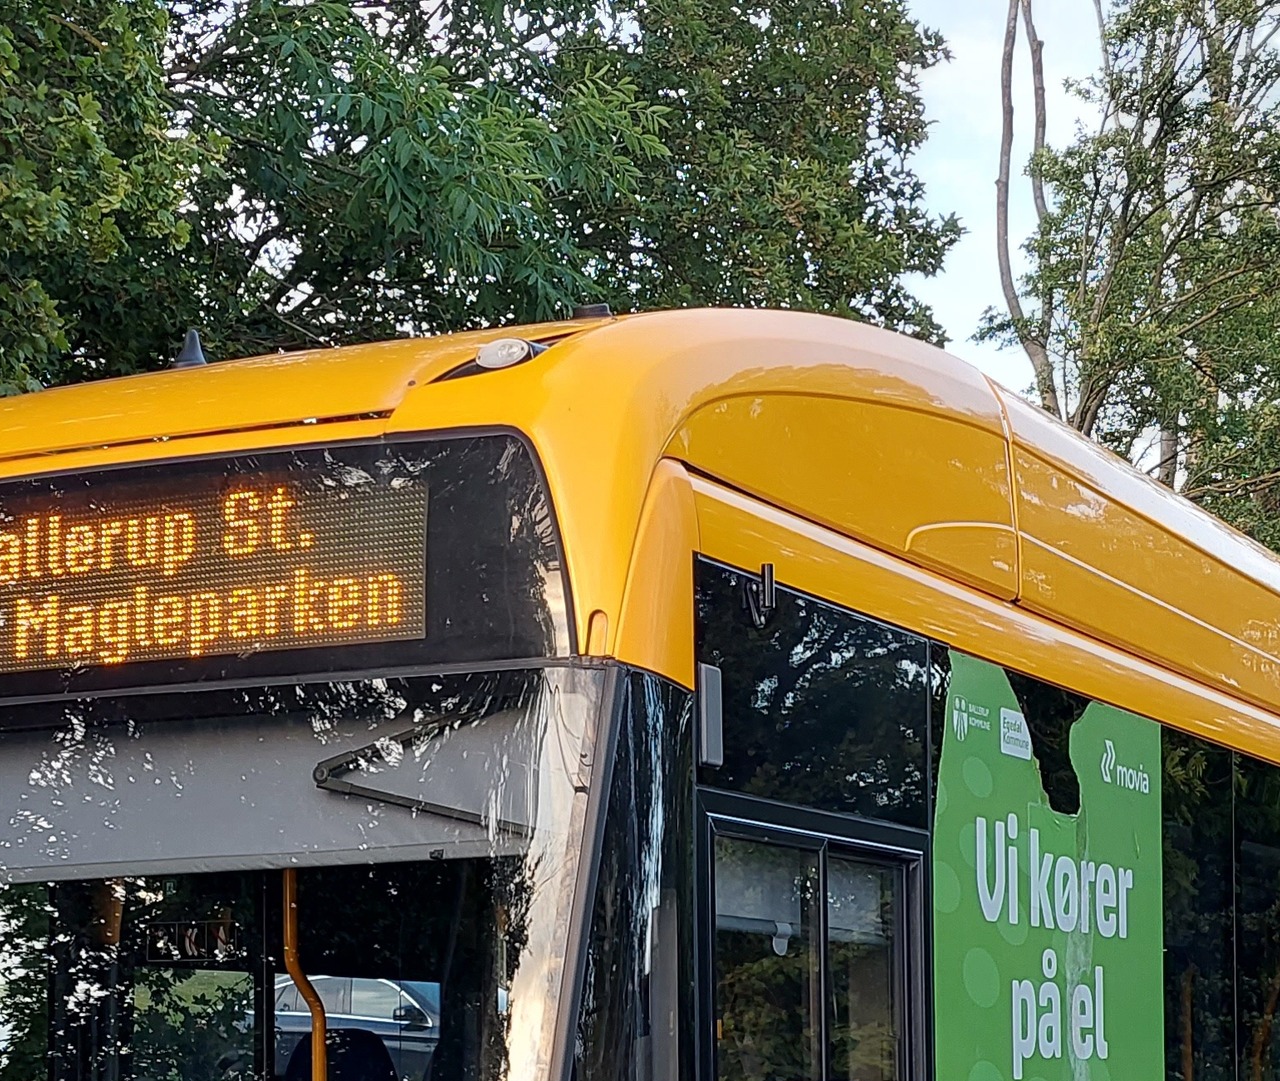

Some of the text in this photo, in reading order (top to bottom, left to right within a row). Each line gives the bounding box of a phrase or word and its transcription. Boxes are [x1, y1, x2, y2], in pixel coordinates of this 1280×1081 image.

[222, 486, 312, 557] St.
[15, 570, 401, 664] Magleparken
[1116, 764, 1150, 794] movia
[976, 813, 1133, 939] Vi kører
[1012, 949, 1108, 1080] på el
